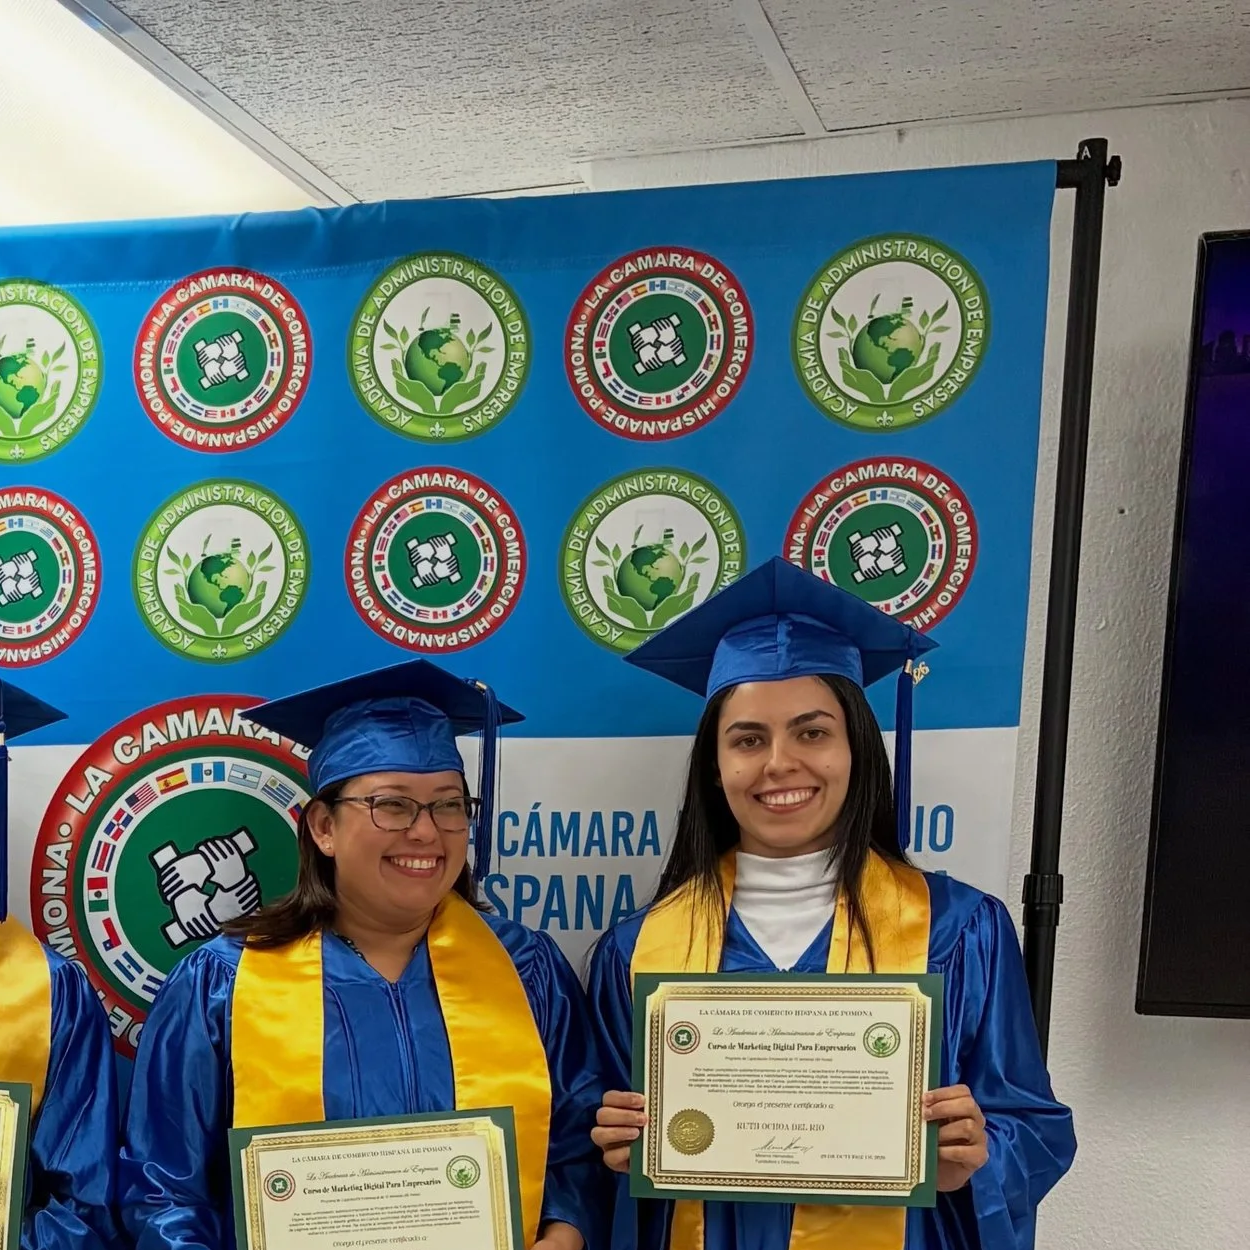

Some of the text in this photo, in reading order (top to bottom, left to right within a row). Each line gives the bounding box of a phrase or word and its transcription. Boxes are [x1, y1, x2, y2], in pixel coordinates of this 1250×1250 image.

[79, 337, 97, 361] DE
[153, 304, 175, 327] LA
[176, 274, 254, 302] CAMARA
[260, 284, 284, 307] DE
[278, 308, 306, 411] COMERCIO
[356, 258, 524, 431] ACADEMIA DE ADMINISTRACION DE EMPRESAS
[585, 285, 608, 308] LA
[611, 254, 694, 283] CAMARA
[700, 263, 726, 287] DE
[717, 289, 747, 397] COMERCIO
[800, 241, 983, 417] ACADEMIA DE ADMINISTRACION DE EMPRESAS
[41, 369, 96, 449] EMPRESAS
[52, 504, 74, 526] DE
[70, 527, 95, 627] COMERCIO
[140, 486, 303, 649] ACADEMIA DE ADMINISTRACION DE EMPRESAS
[365, 501, 387, 523] LA
[389, 474, 468, 498] CAMARA
[474, 488, 498, 512] DE
[491, 514, 520, 617] COMERCIO
[567, 475, 739, 641] ACADEMIA DE ADMINISTRACION DE
[805, 464, 971, 605] LA CAMARA DE COMERCIO
[65, 765, 113, 814] LA
[497, 802, 661, 857] CÁMARA
[484, 873, 637, 931] SPANA
[708, 1042, 727, 1050] Curso
[737, 1042, 771, 1051] Marketing
[773, 1043, 795, 1051] Digital
[797, 1043, 813, 1051] Para
[814, 1043, 857, 1053] Empresarios
[737, 1122, 760, 1130] RUTH
